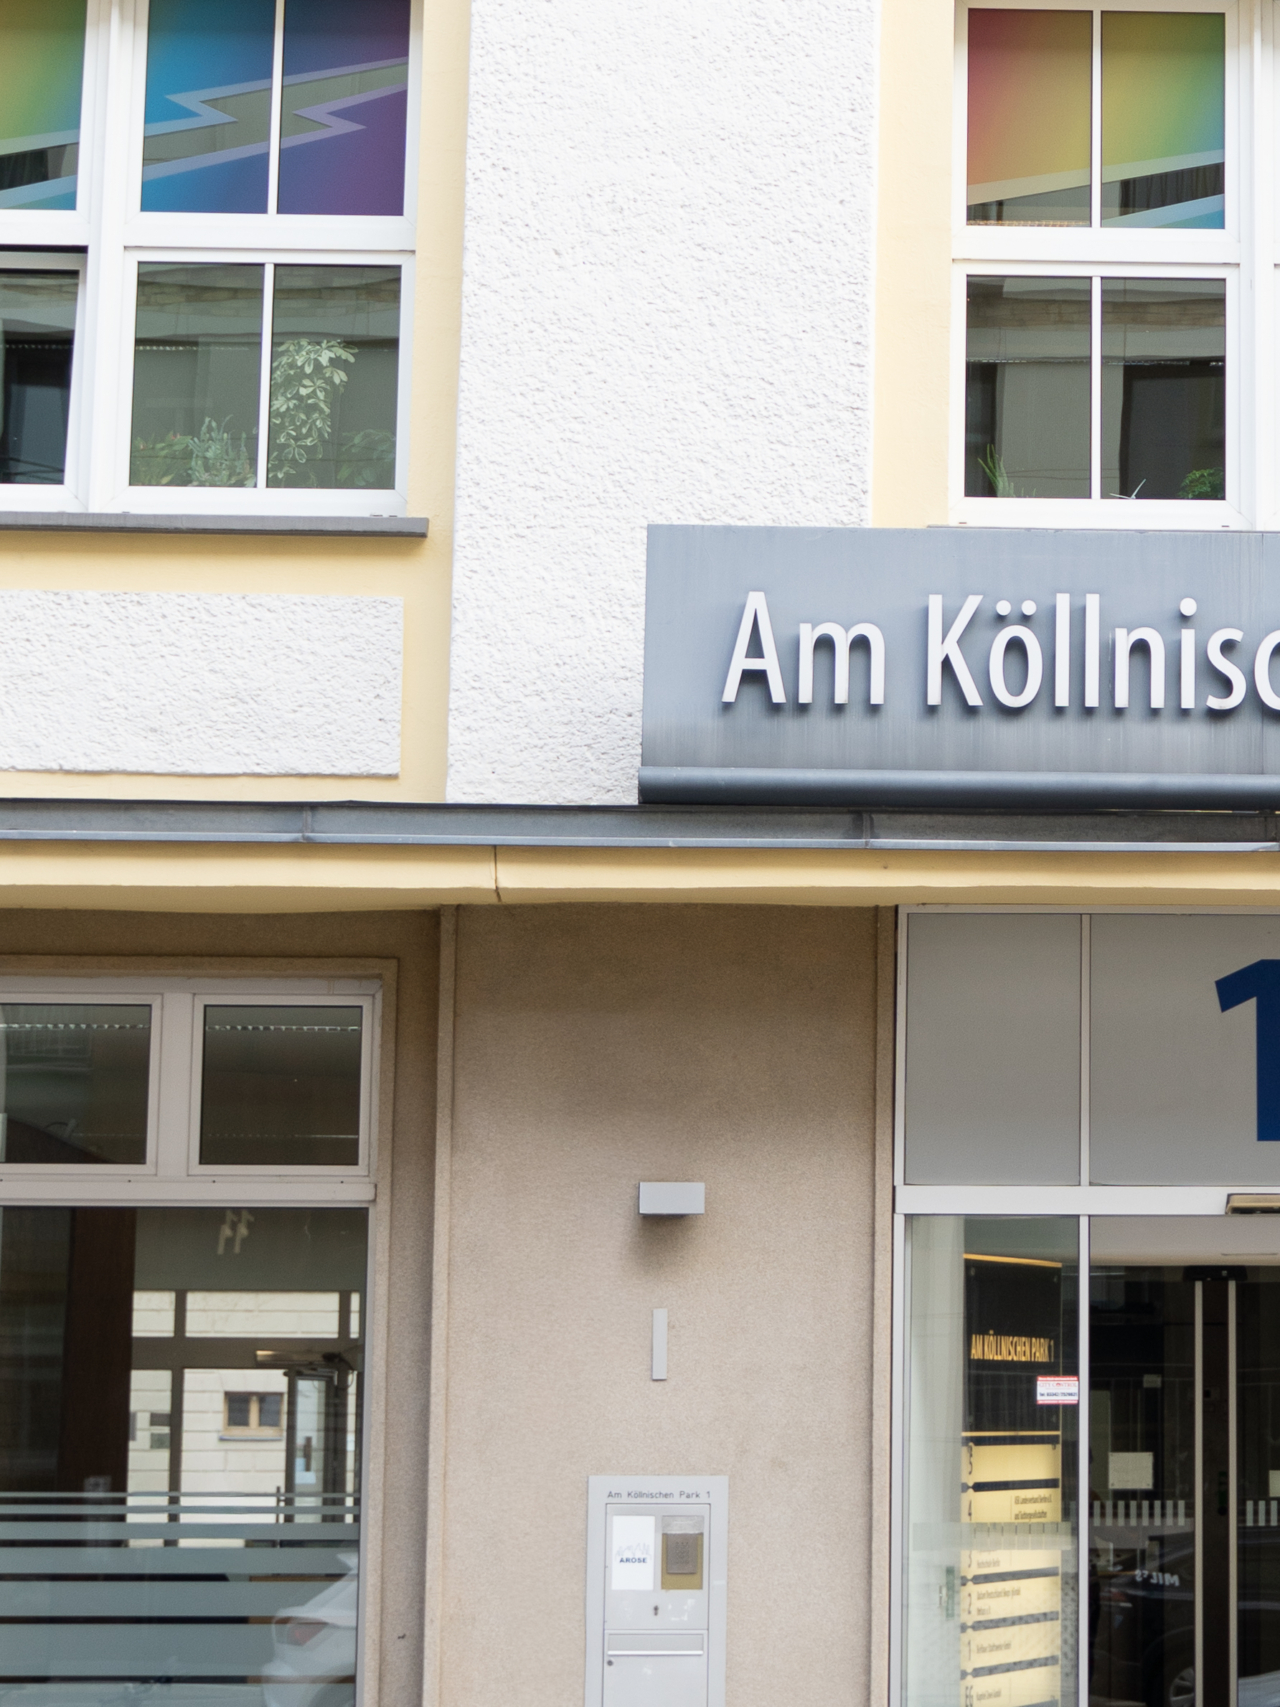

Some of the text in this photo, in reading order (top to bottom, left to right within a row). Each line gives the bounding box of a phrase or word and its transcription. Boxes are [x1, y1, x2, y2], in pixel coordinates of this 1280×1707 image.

[722, 591, 885, 704] Am
[970, 1329, 1054, 1362] AM KÖLLNISCHEN PARK 1
[607, 1490, 711, 1499] Am Köllnischen Park 1
[967, 1500, 973, 1521] 4
[619, 1556, 648, 1564] AROSE
[967, 1592, 973, 1615] 2
